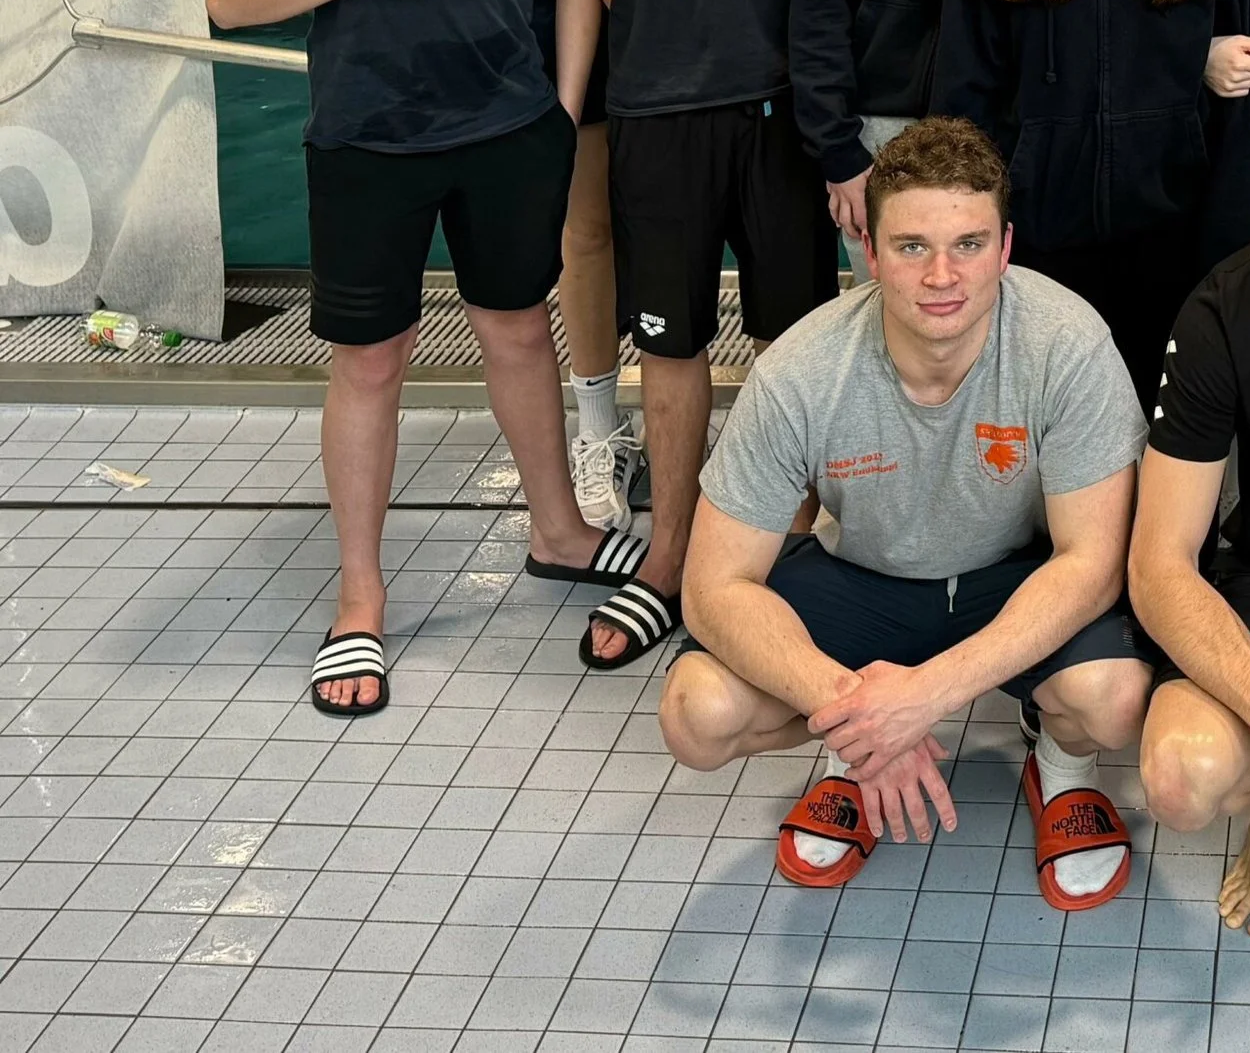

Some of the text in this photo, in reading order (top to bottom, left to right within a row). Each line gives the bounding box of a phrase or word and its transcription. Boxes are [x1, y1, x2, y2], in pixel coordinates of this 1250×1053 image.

[640, 312, 666, 326] arena
[822, 791, 840, 804] THE
[807, 802, 837, 817] NORTH
[1068, 803, 1093, 815] THE
[808, 811, 838, 824] FACE
[1051, 814, 1094, 833] NORTH
[1065, 825, 1097, 838] FACE
